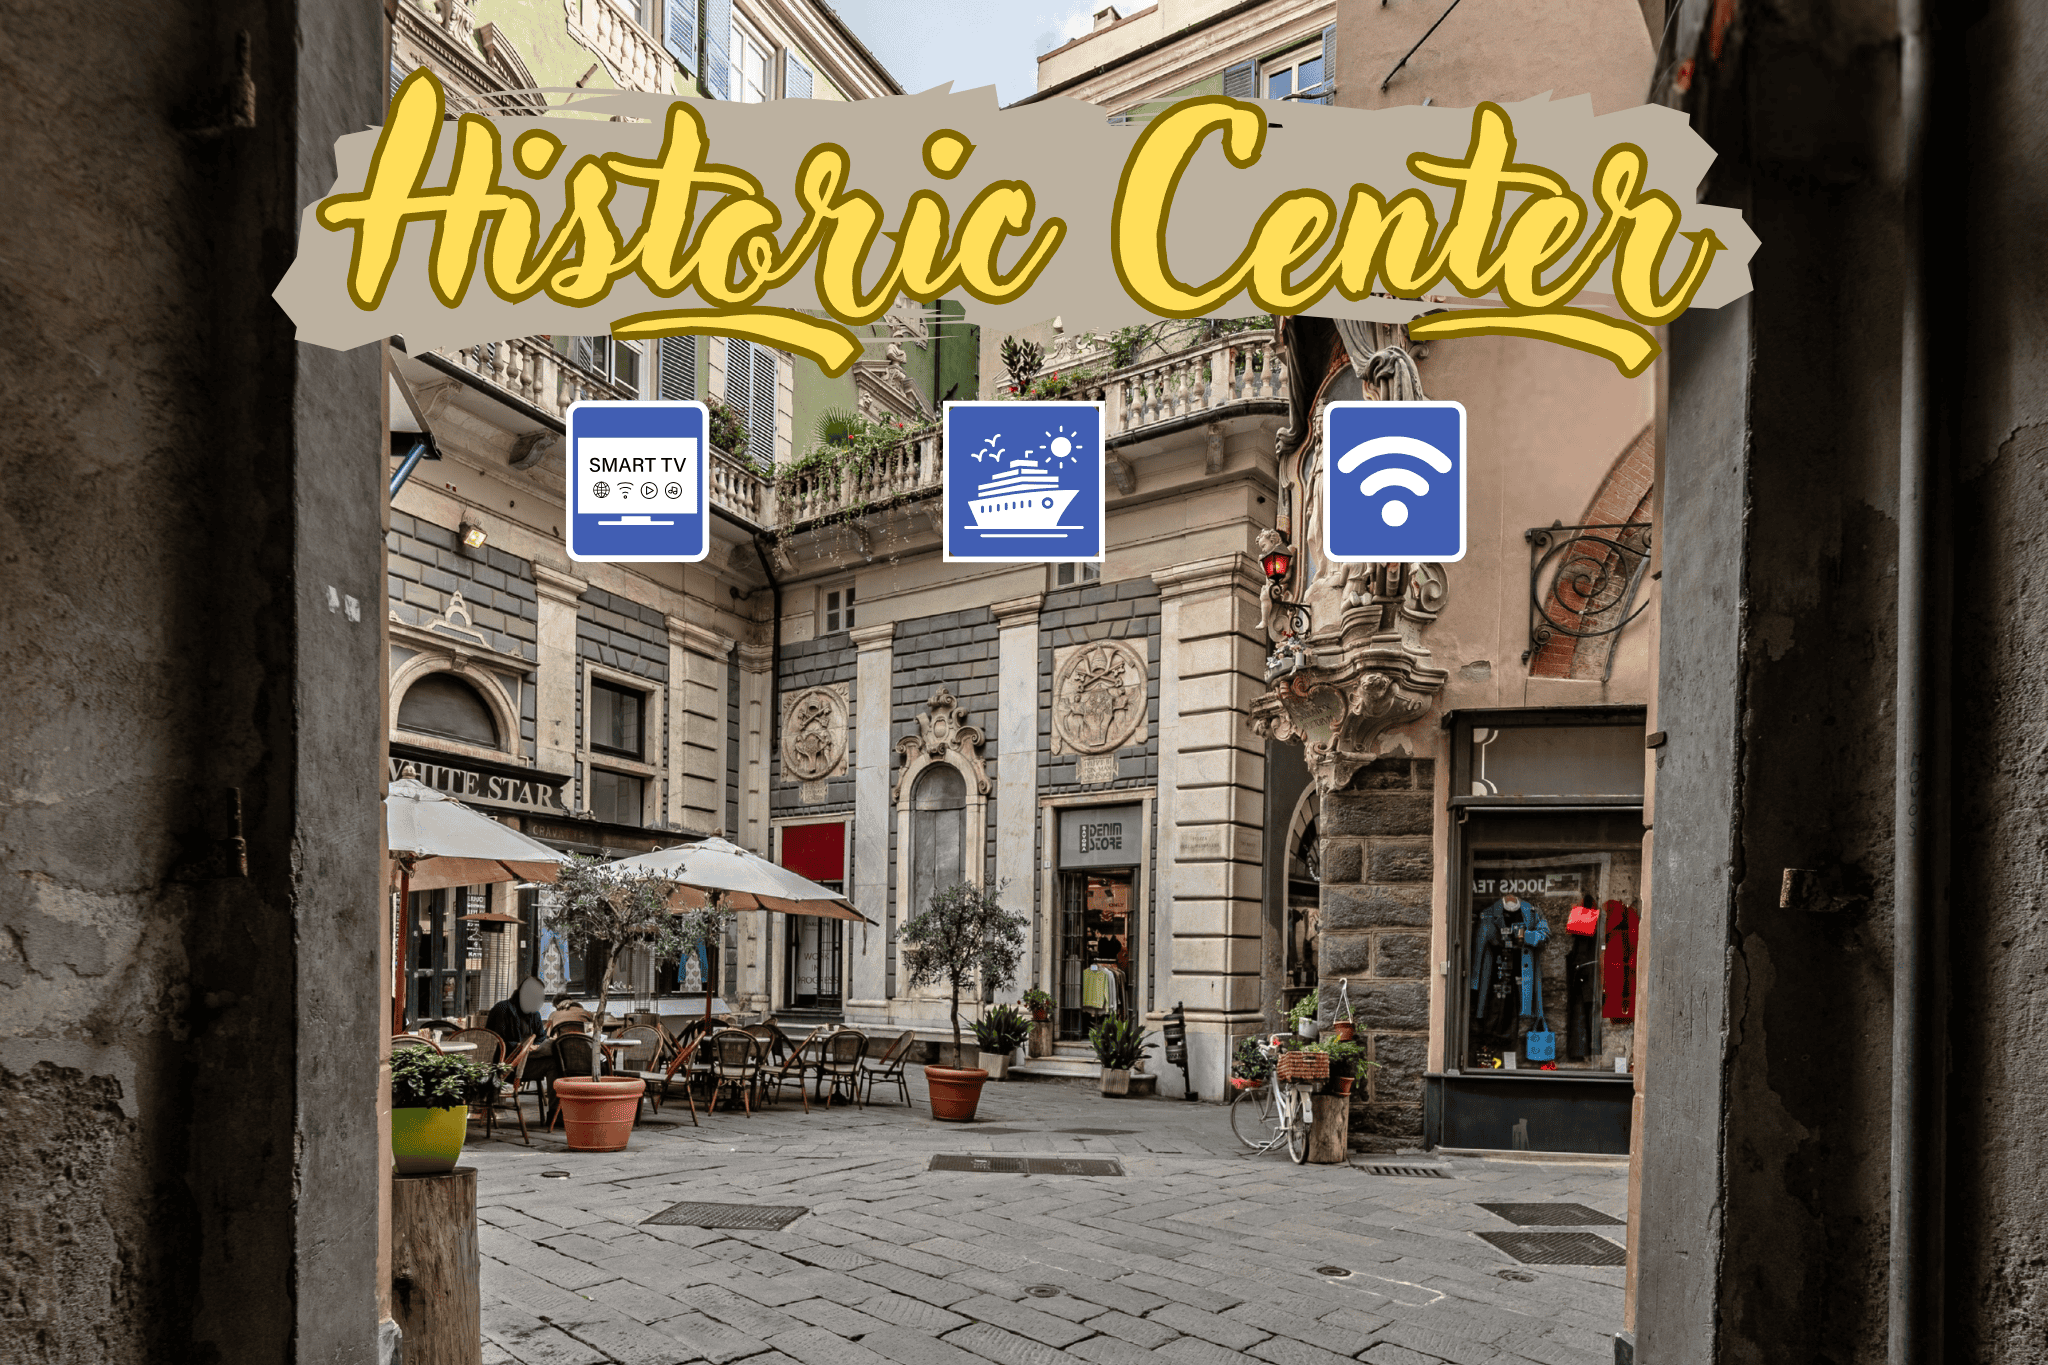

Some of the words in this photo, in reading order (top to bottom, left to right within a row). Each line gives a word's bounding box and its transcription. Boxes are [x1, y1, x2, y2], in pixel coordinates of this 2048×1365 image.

[488, 776, 554, 808] STAR
[532, 824, 585, 842] CRAVATTE
[1090, 823, 1122, 837] DENIM
[1090, 837, 1122, 851] STORE
